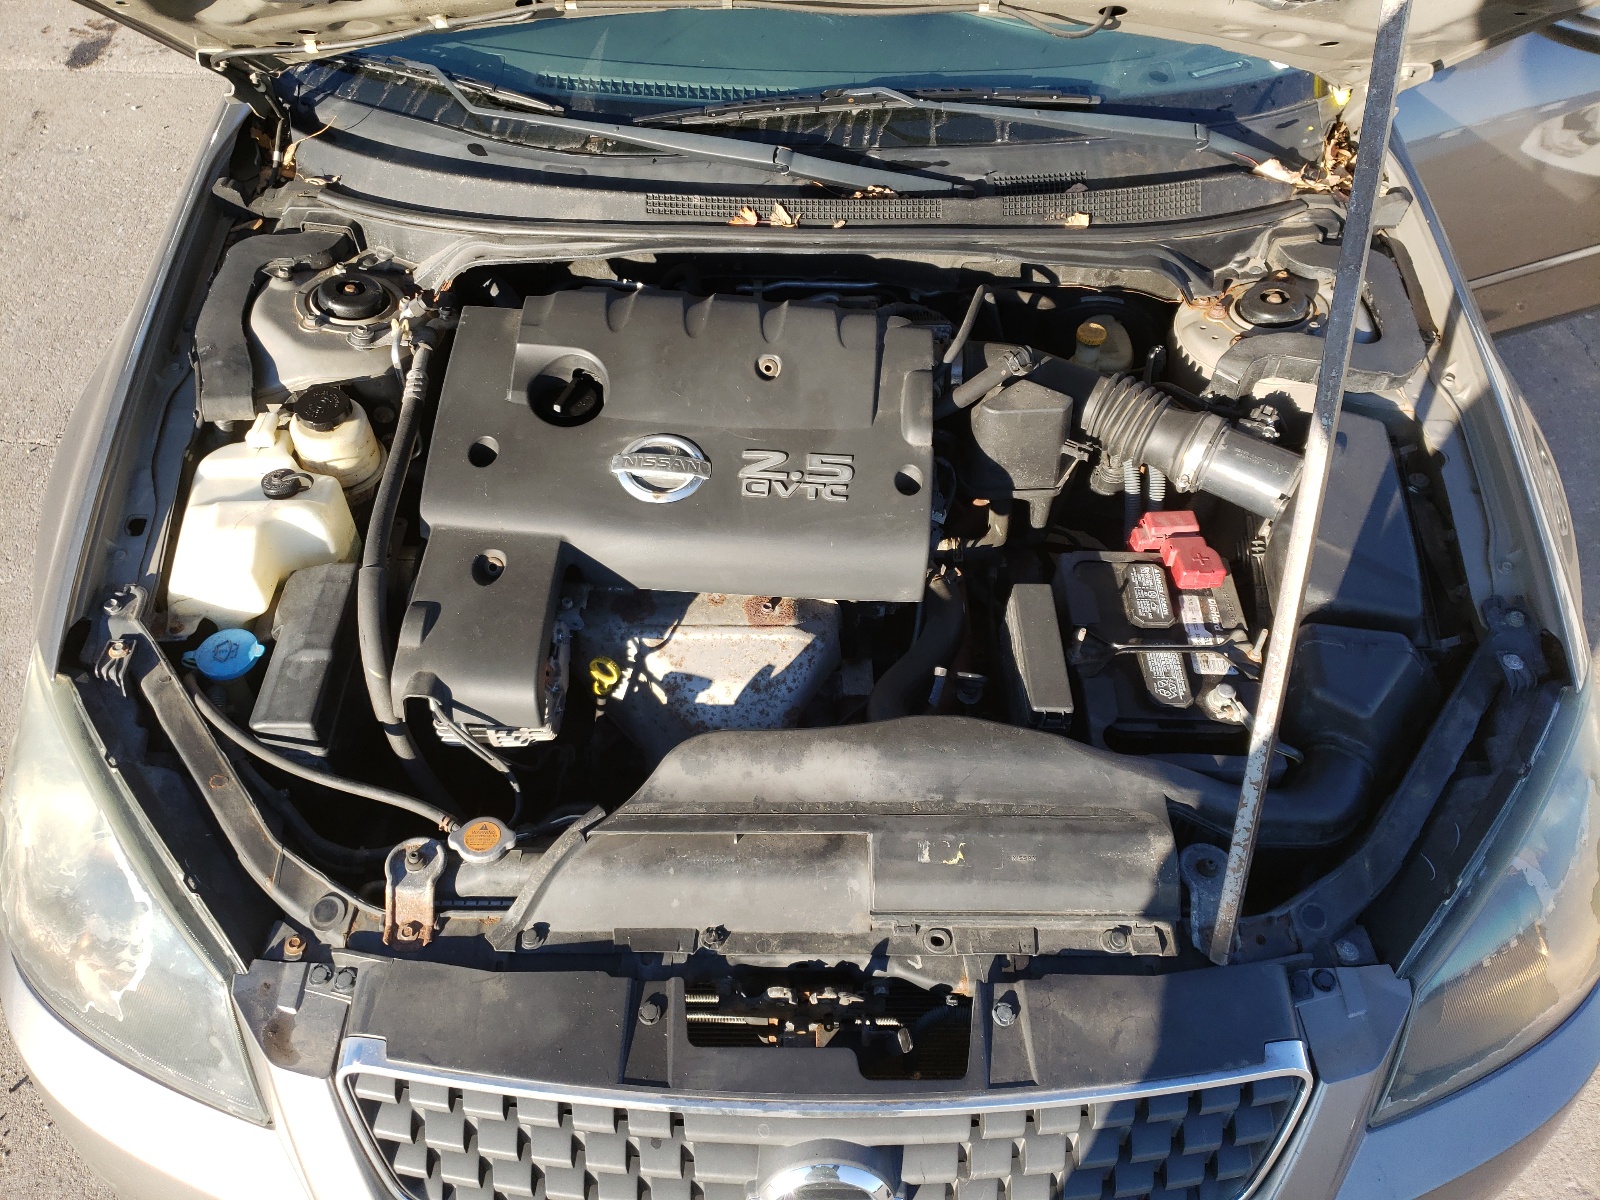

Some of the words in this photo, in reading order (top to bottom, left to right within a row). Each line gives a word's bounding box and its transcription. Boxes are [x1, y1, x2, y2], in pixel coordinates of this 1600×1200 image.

[622, 455, 706, 473] NISSAN
[739, 449, 854, 483] 2.5
[1207, 598, 1224, 632] DieHard
